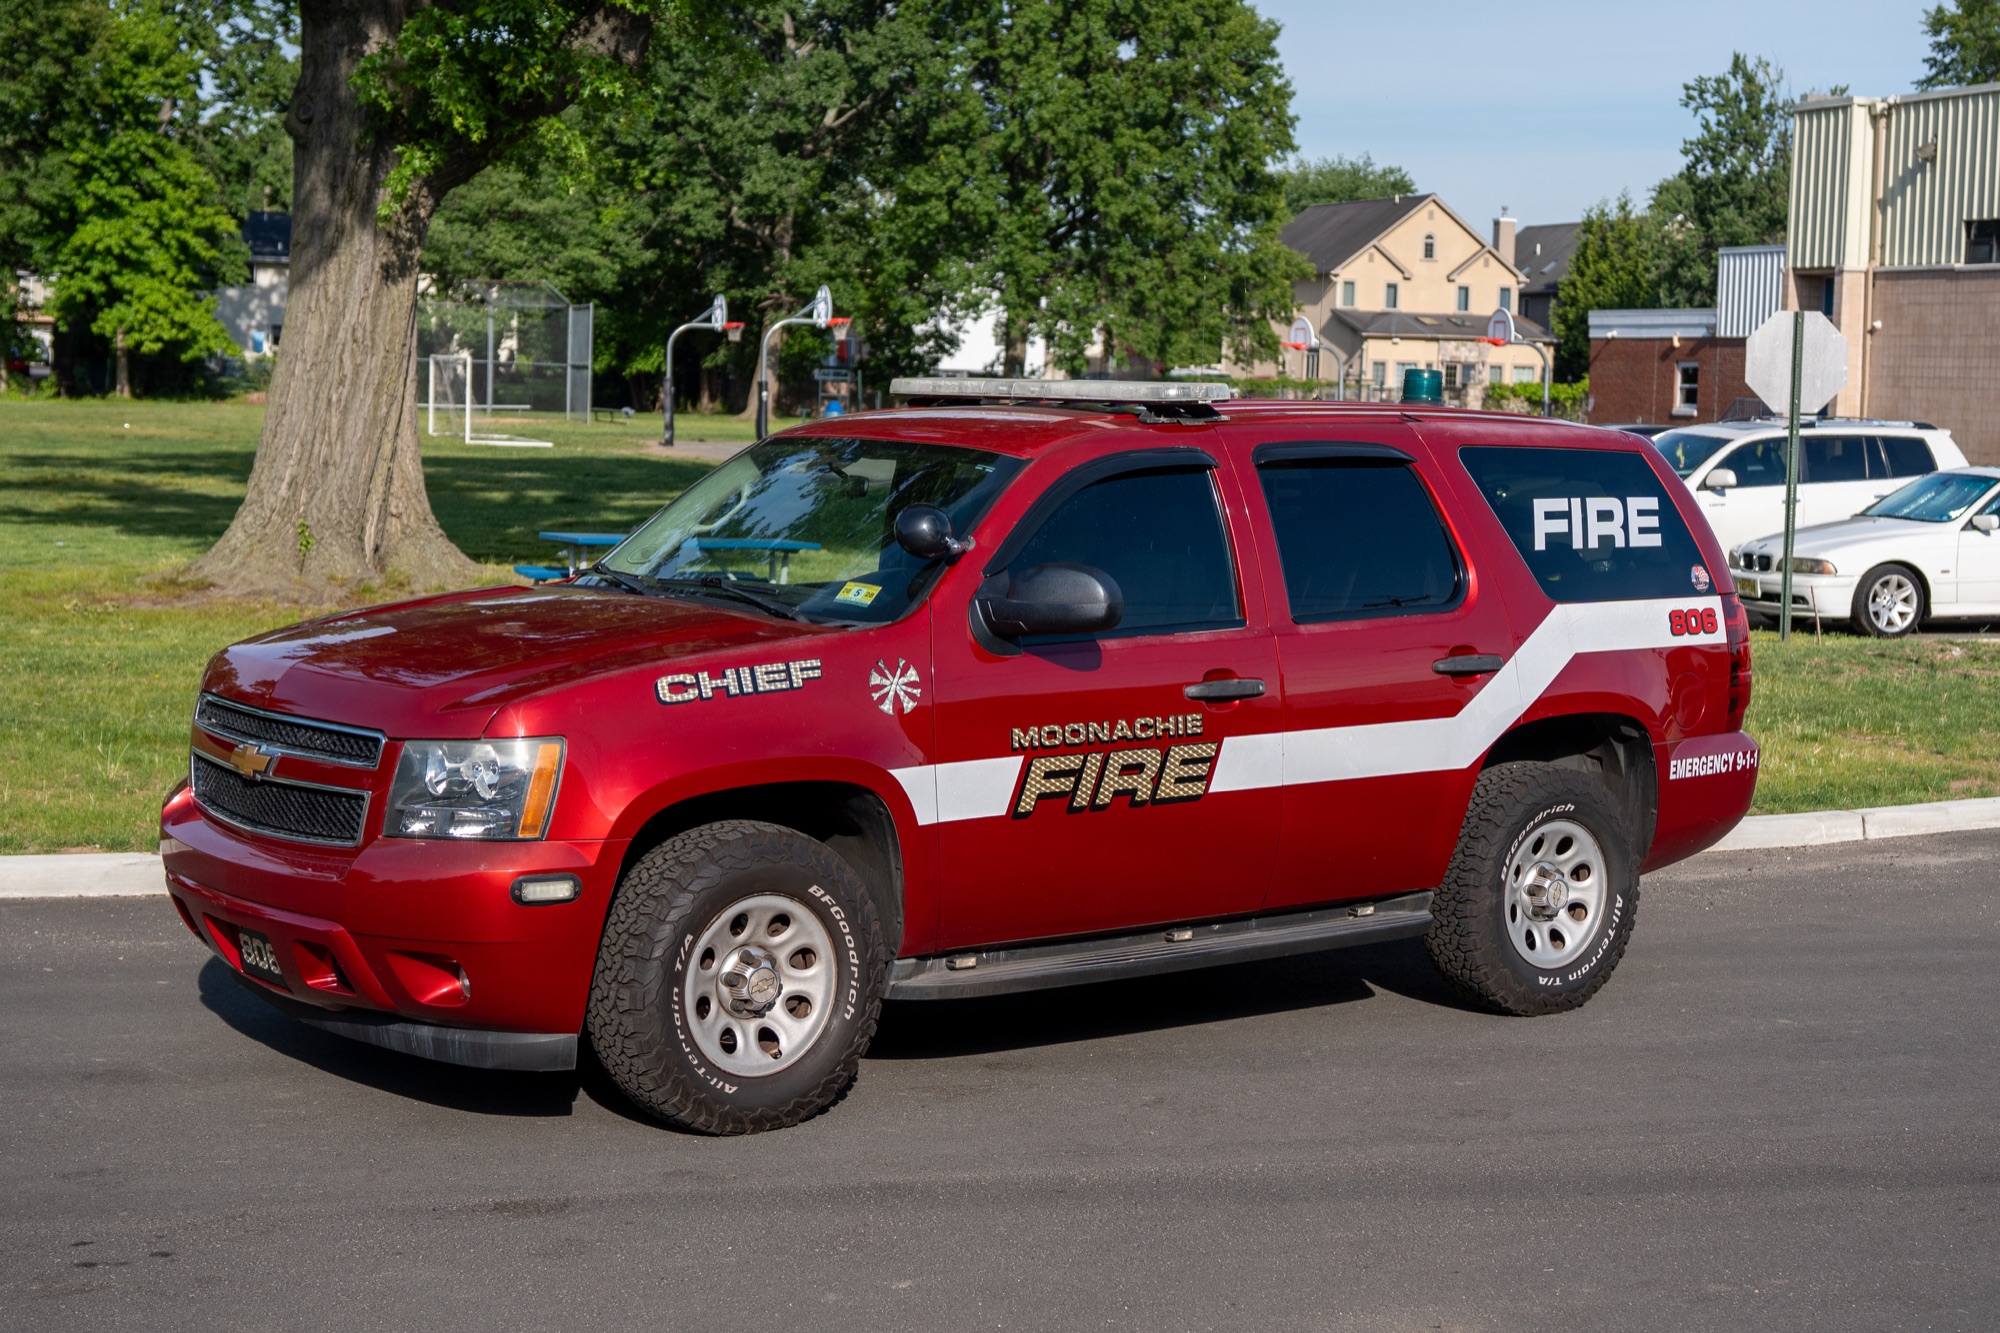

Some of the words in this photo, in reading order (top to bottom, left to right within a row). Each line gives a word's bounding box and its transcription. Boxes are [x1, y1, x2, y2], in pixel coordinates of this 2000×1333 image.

[1533, 496, 1662, 551] FIRE
[1669, 607, 1719, 637] 806
[655, 658, 822, 705] CHIEF
[1011, 713, 1204, 751] MOONACHIE
[1011, 742, 1219, 819] FIRE
[1669, 751, 1736, 780] EMERGENCY
[1736, 748, 1758, 771] 9-1-1
[1500, 803, 1575, 881] BFGoodrich
[239, 932, 282, 975] 806
[675, 933, 694, 972] T/A
[807, 884, 861, 1020] BFGoodrich
[1568, 893, 1624, 982] All-Terrain
[1538, 975, 1563, 986] T/A
[671, 987, 739, 1094] All-Terrain
